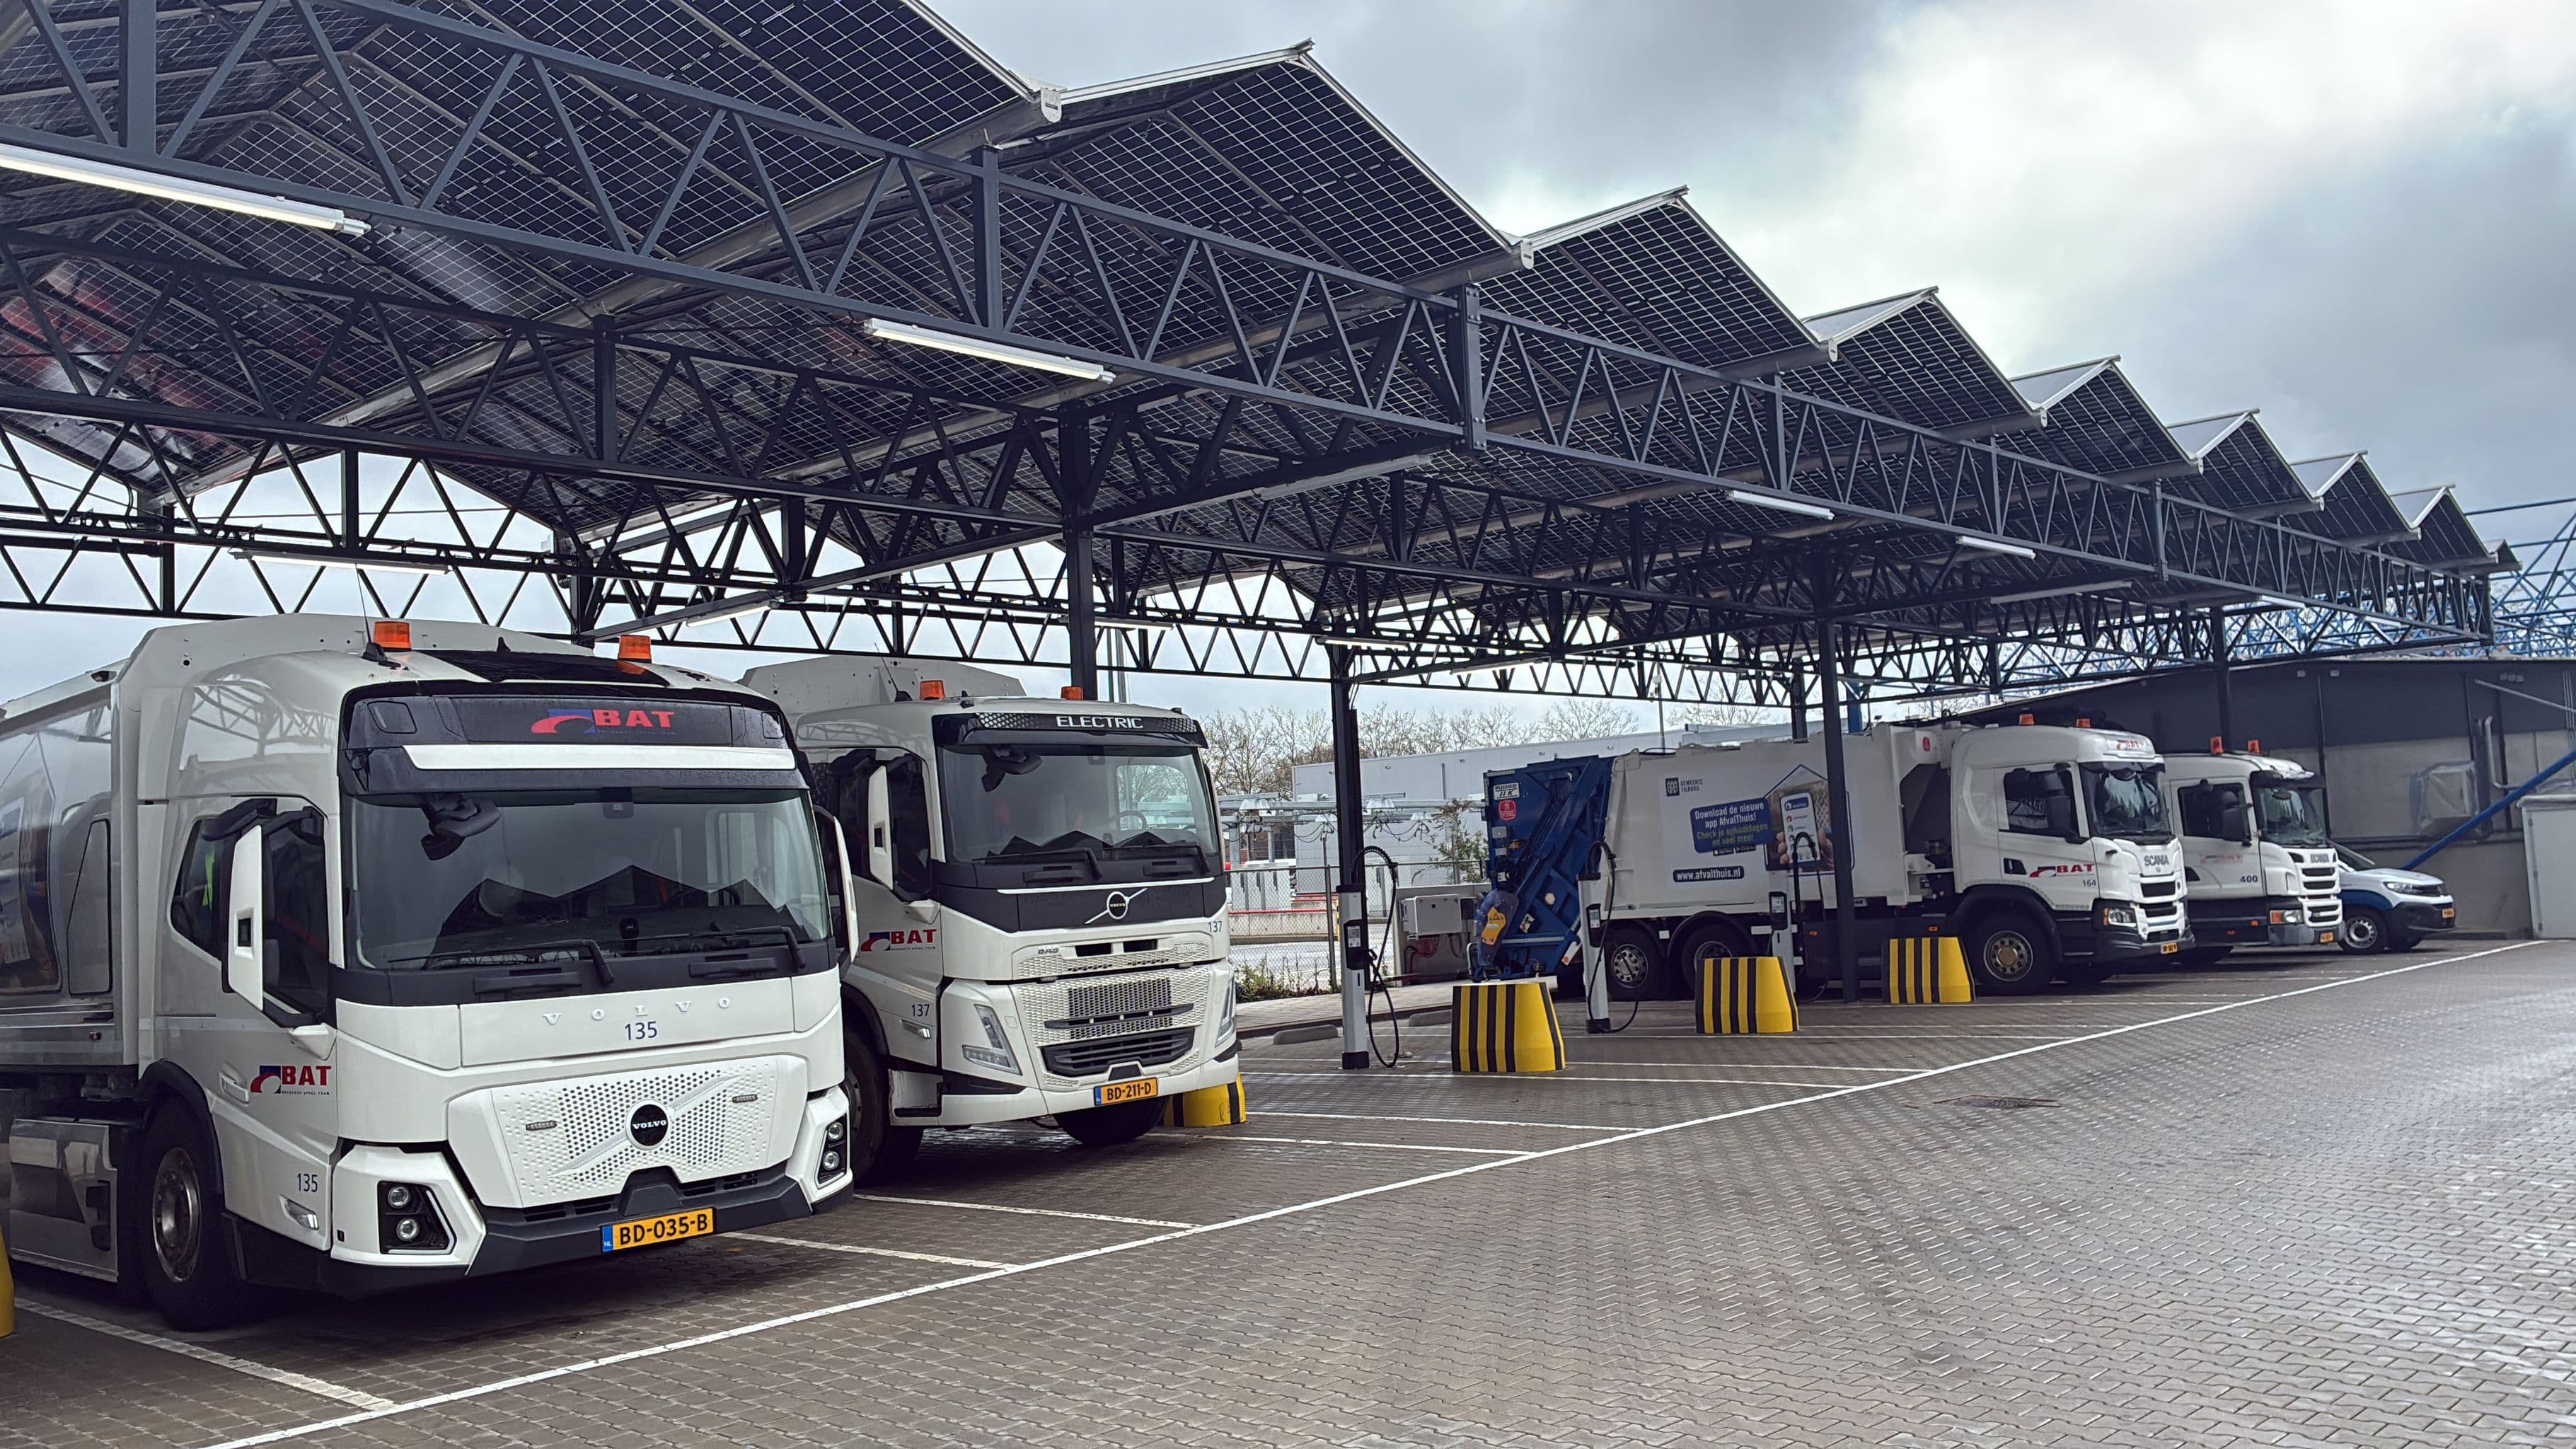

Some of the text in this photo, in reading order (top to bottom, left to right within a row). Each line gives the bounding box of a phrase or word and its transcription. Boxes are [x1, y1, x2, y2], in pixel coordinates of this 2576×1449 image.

[593, 710, 675, 727] BAT
[1056, 716, 1143, 728] ELECTRIC
[1694, 803, 1764, 820] Download de nieuwe
[1705, 819, 1718, 829] app
[1677, 867, 1740, 880] www.afvalthuis.nl
[2057, 863, 2095, 872] BAT
[2082, 879, 2097, 887] 164
[1208, 921, 1223, 933] 137
[891, 929, 937, 945] BAT
[543, 998, 731, 1024] VOLVO
[911, 1004, 930, 1017] 137
[625, 1021, 658, 1041] 135
[282, 1066, 332, 1086] BAT
[1107, 1083, 1152, 1101] BD-211-D
[633, 1119, 667, 1130] VOLVO
[296, 1173, 318, 1193] 135
[620, 1213, 707, 1245] BD-035-B
